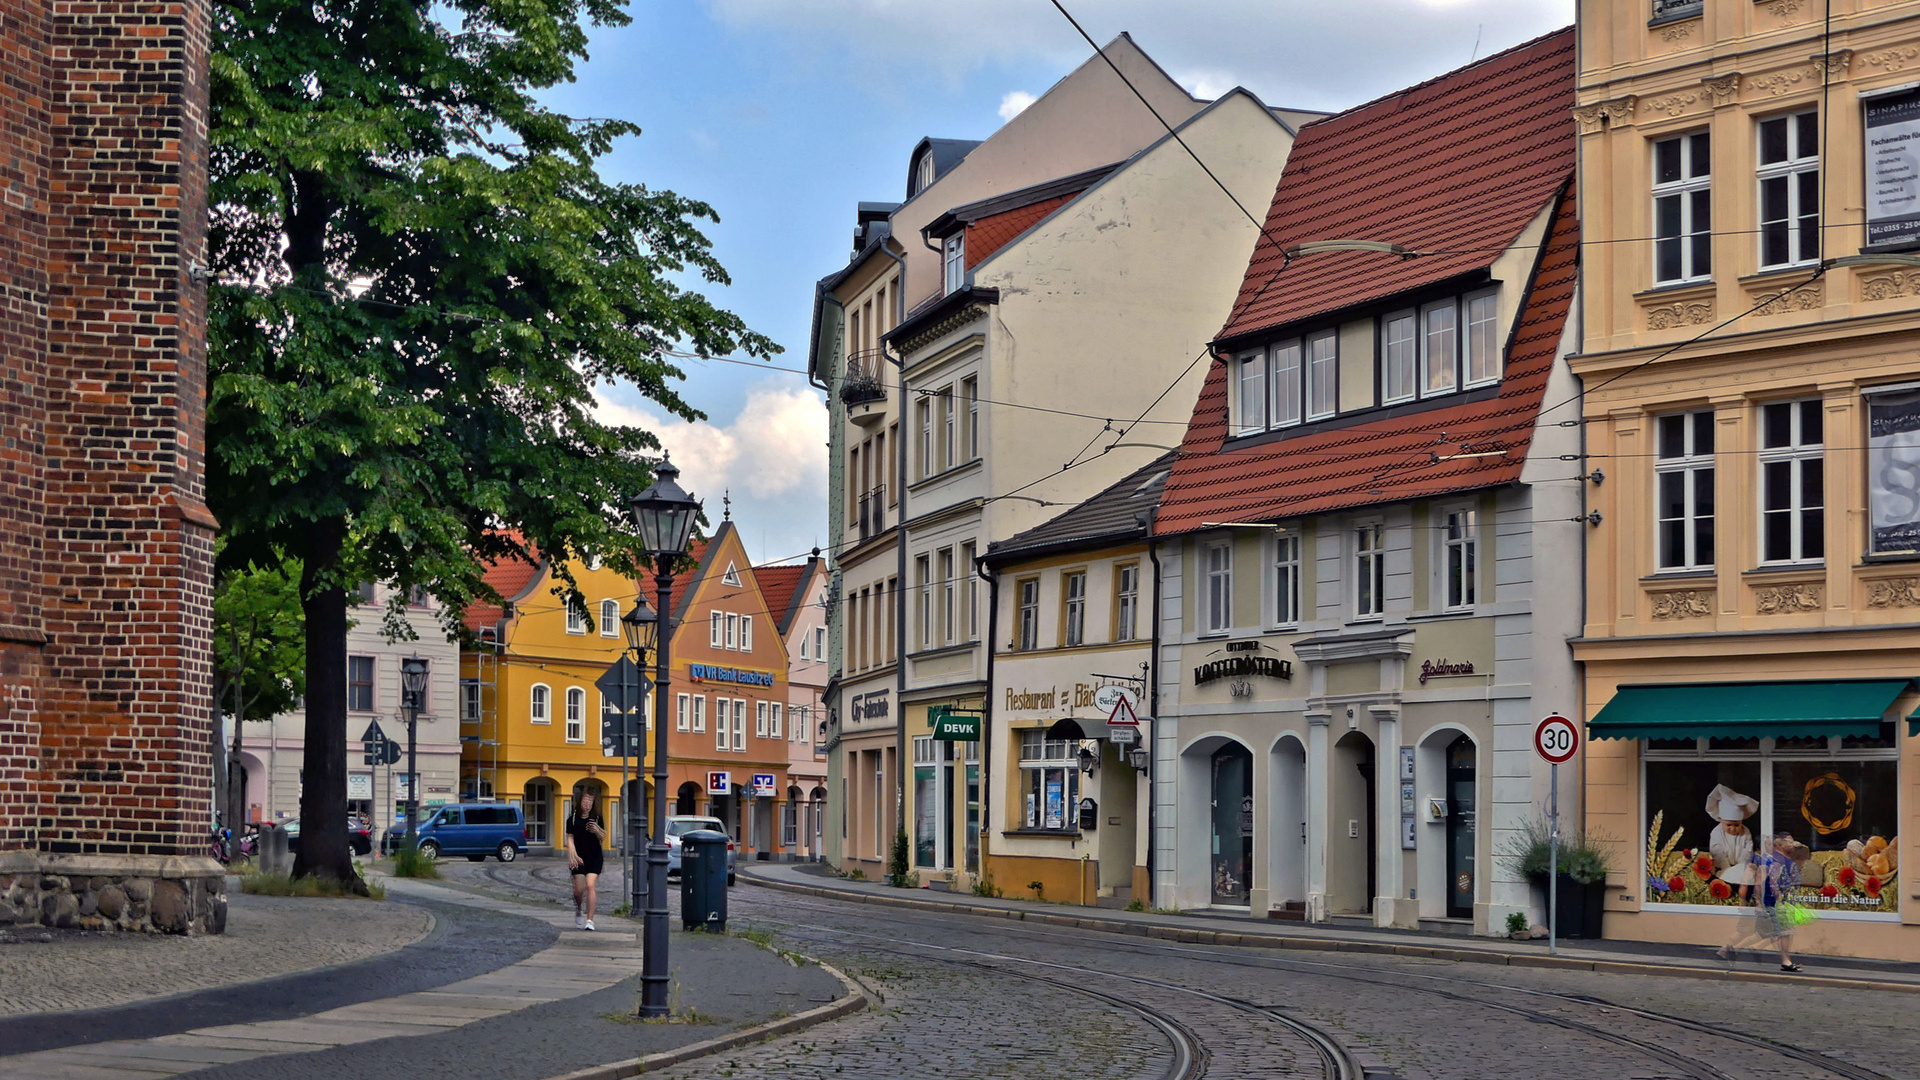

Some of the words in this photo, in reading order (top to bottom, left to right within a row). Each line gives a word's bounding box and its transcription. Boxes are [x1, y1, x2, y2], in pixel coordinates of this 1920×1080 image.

[1871, 134, 1911, 146] Fachanwälte
[1883, 223, 1900, 233] 0355
[1904, 221, 1913, 230] 25
[705, 665, 717, 679] VR
[718, 667, 737, 681] Bank
[738, 669, 762, 685] Lausitz
[763, 672, 775, 686] eG
[1419, 658, 1475, 685] Goldmarie
[1006, 685, 1056, 711] Restaurant
[943, 723, 975, 734] DEVK
[1543, 728, 1570, 750] 30
[1820, 894, 1831, 904] in
[1832, 894, 1848, 904] die
[1850, 894, 1881, 906] Natur
